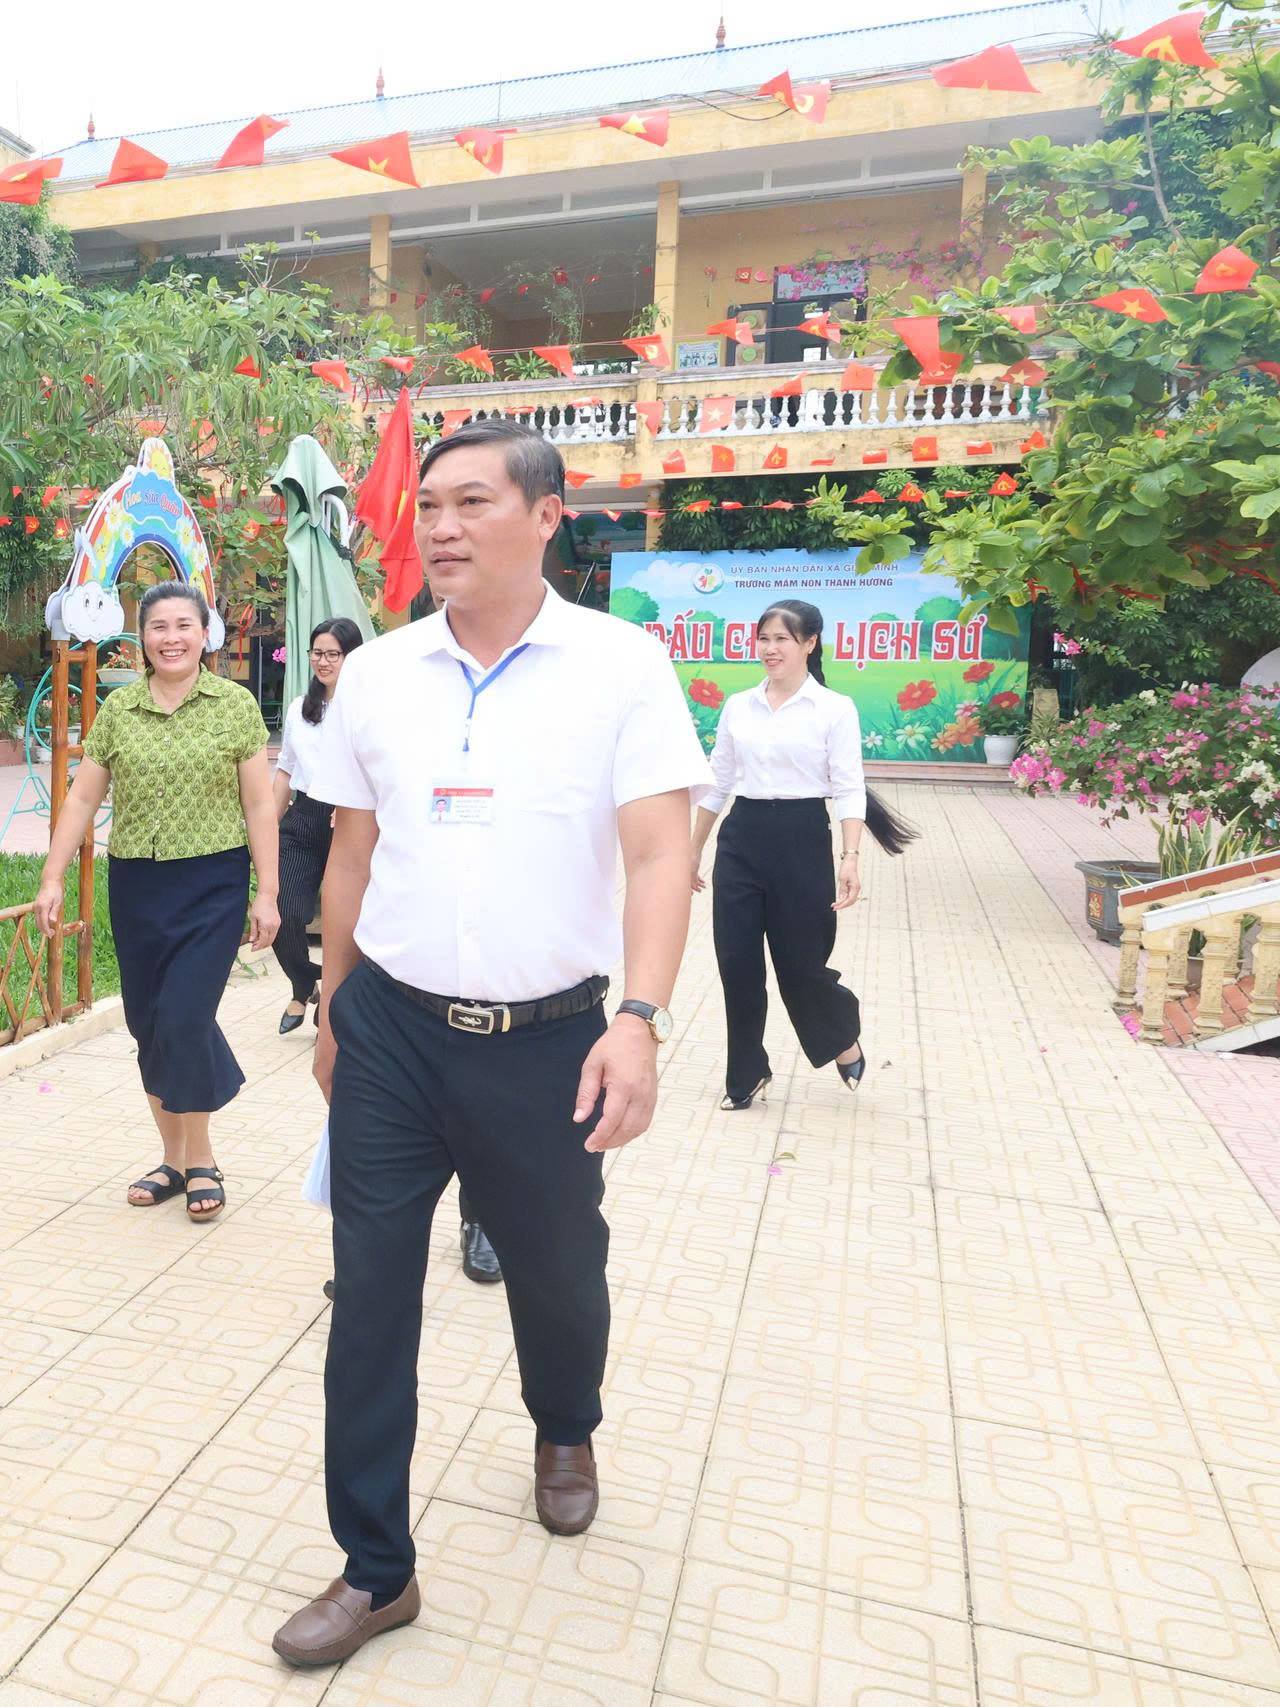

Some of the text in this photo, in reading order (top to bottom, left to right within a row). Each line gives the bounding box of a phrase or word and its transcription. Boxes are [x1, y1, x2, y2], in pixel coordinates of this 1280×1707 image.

[747, 565, 768, 574] BAN
[801, 579, 821, 588] NON
[825, 578, 857, 587] THANH
[834, 621, 921, 670] LỊCH
